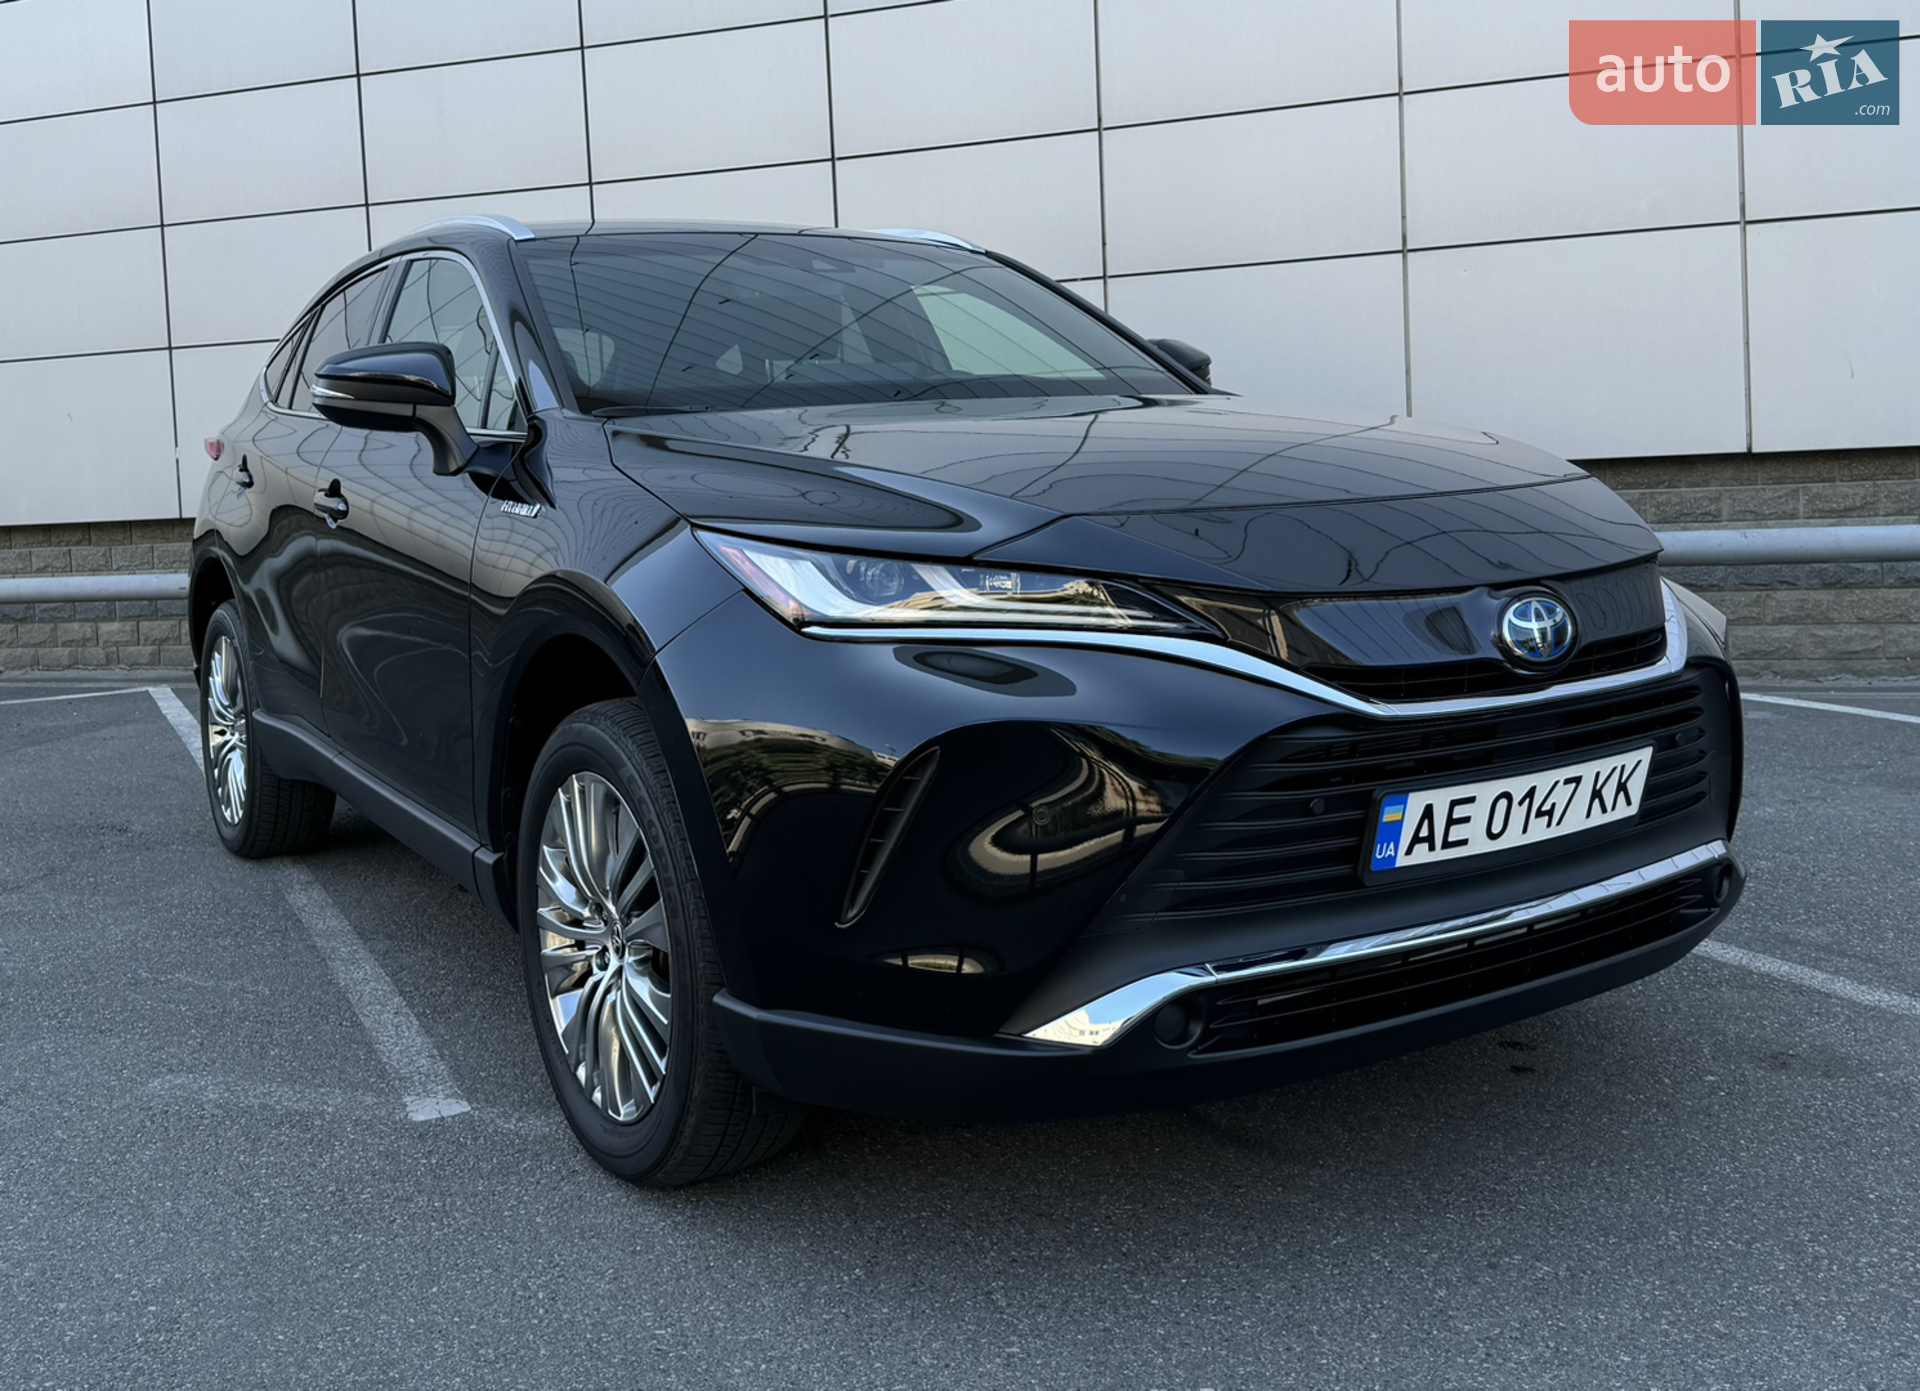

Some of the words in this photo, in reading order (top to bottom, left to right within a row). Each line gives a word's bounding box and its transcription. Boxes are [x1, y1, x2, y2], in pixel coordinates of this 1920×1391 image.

[1404, 795, 1477, 857] AE
[1485, 774, 1583, 841] 0147
[1585, 759, 1643, 819] KK
[1375, 841, 1396, 859] UA
